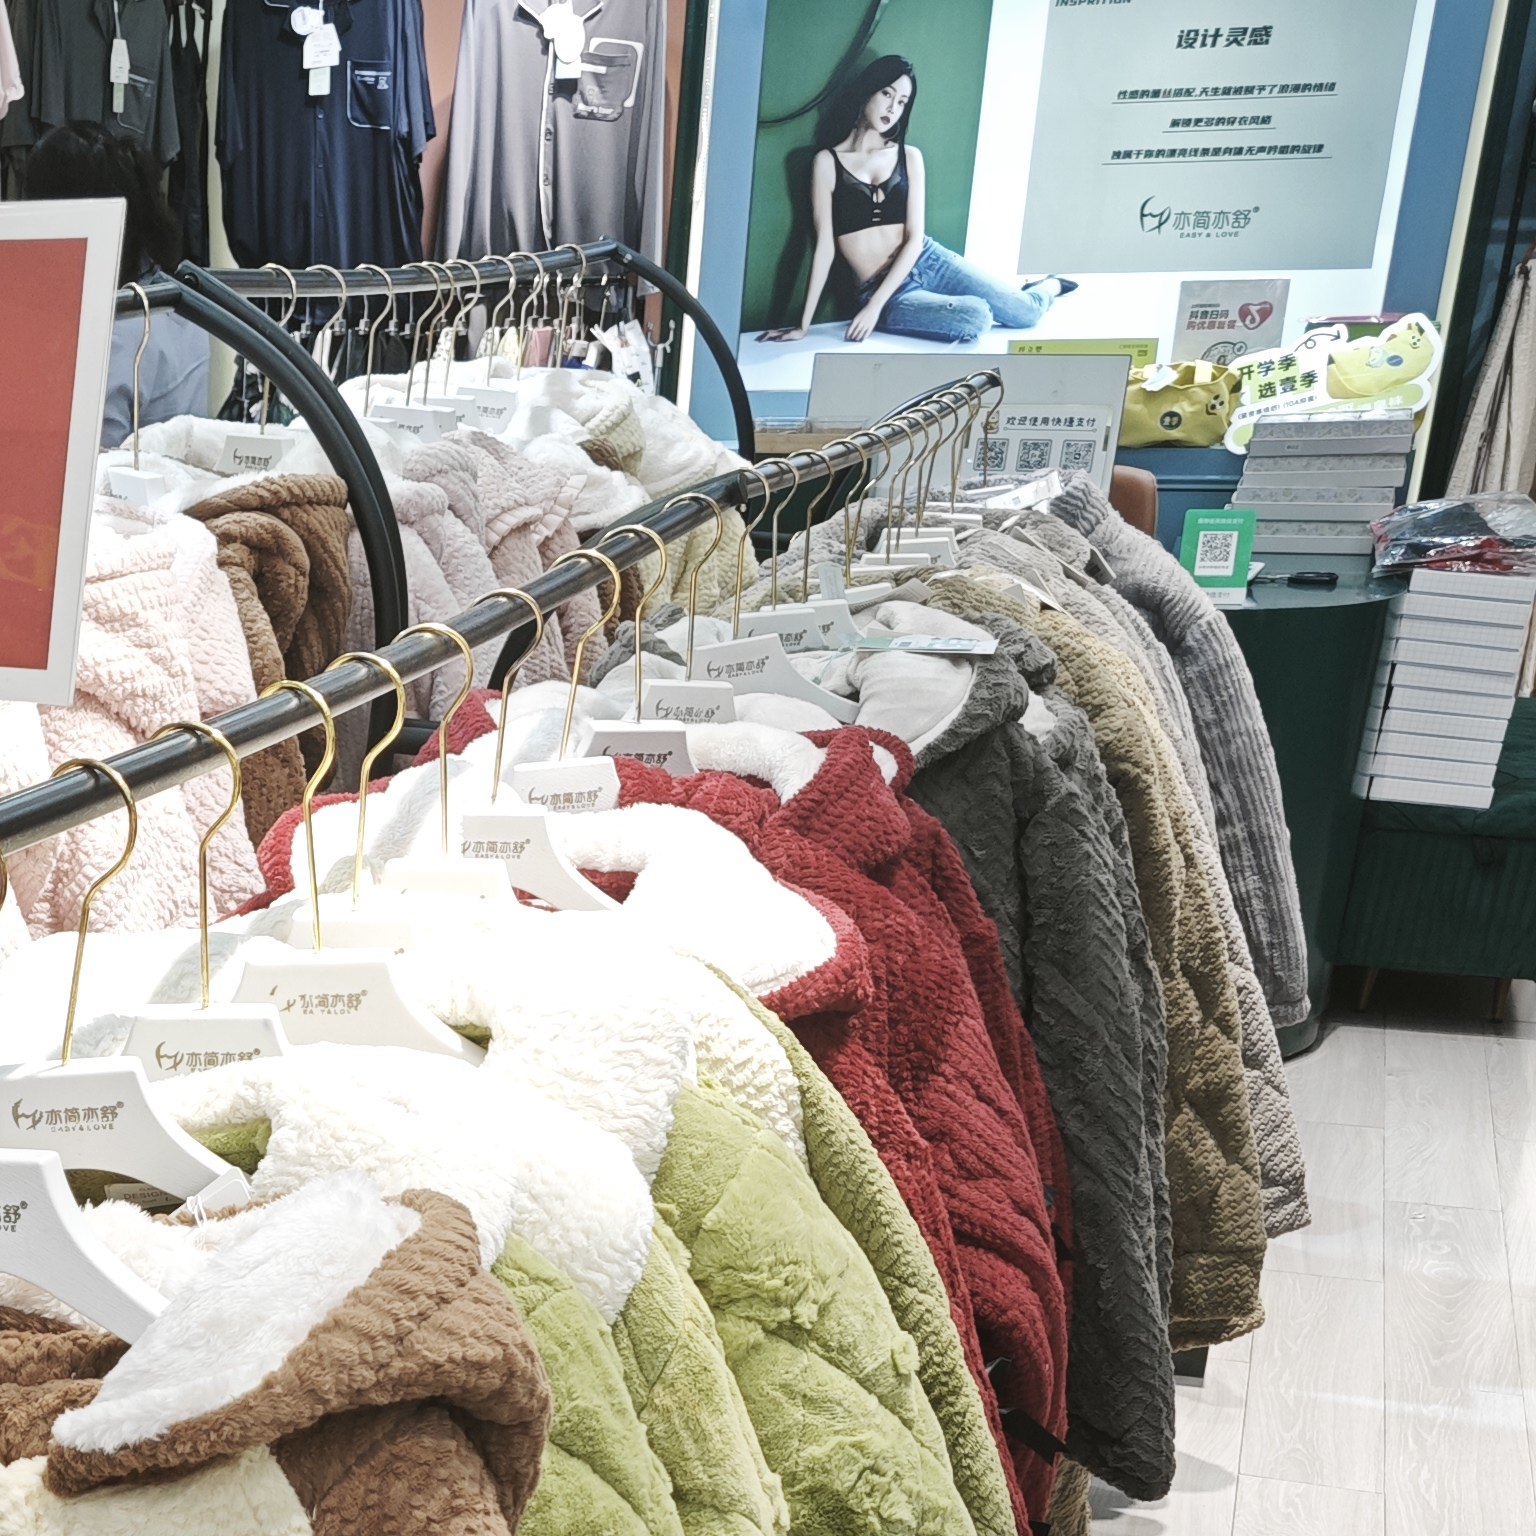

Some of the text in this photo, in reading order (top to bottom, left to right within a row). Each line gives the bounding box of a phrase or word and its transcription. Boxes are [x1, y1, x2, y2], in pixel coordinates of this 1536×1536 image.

[1175, 25, 1274, 50] 设计灵感
[1172, 209, 1252, 231] 亦简亦舒
[1237, 353, 1297, 381] 开学季
[1005, 416, 1096, 428] 欢迎使用快捷支付
[45, 1105, 119, 1126] 亦简亦舒
